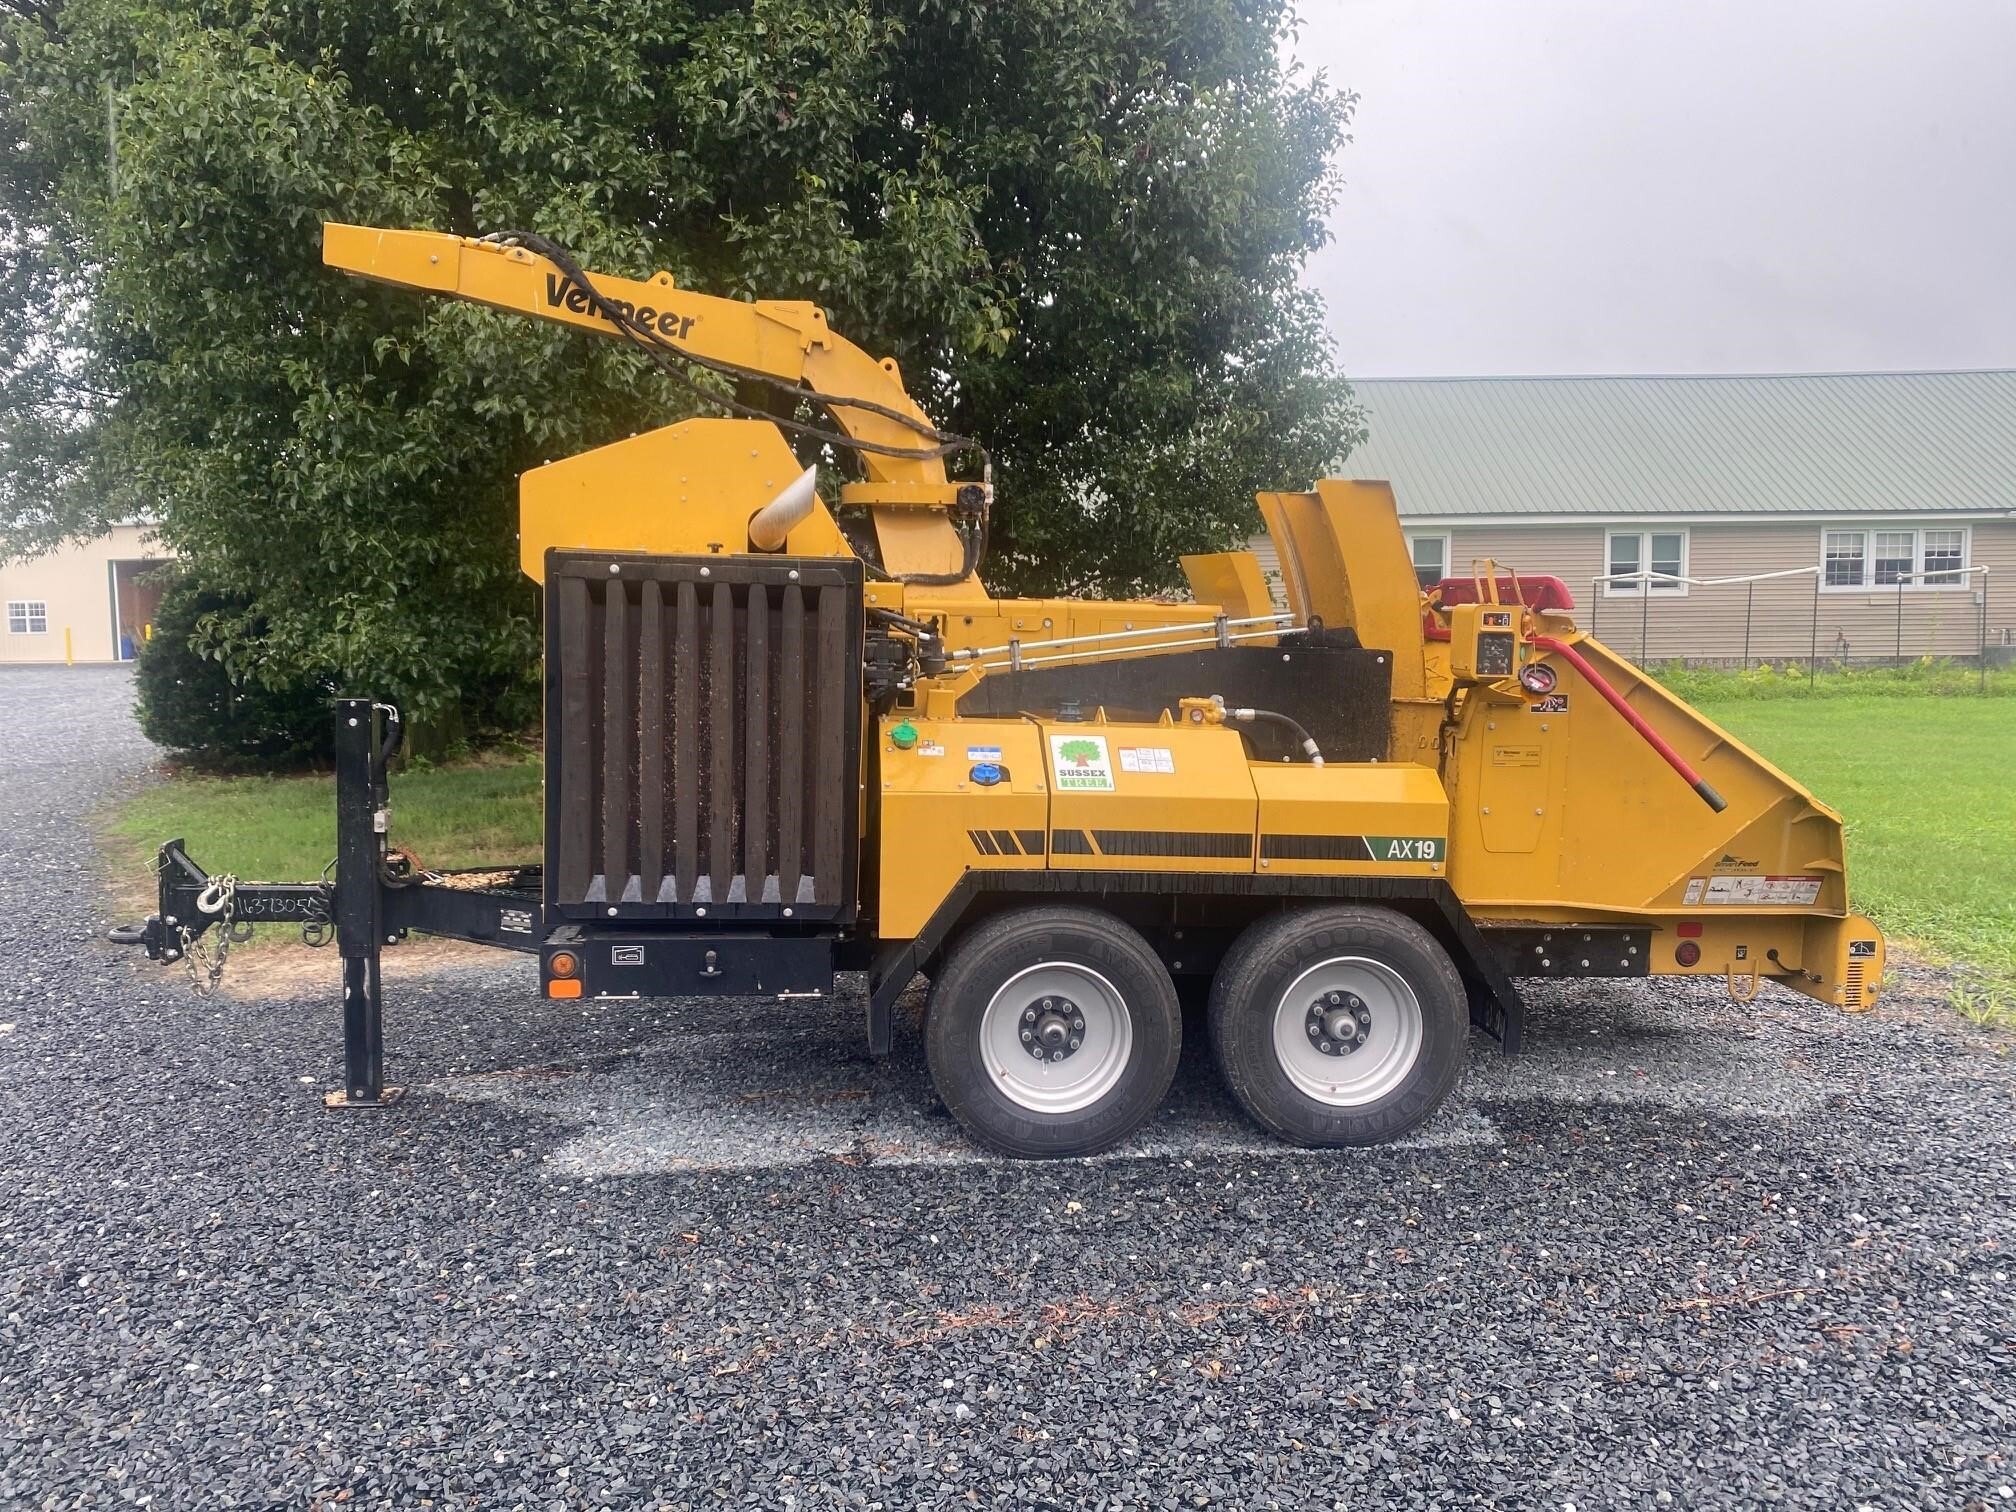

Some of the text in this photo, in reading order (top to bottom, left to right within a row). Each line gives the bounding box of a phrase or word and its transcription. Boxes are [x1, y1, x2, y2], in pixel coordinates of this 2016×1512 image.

[546, 272, 696, 340] Vermeer
[1059, 769, 1106, 777] SUSSEX
[1062, 778, 1106, 787] TREE
[1387, 839, 1436, 859] AX19
